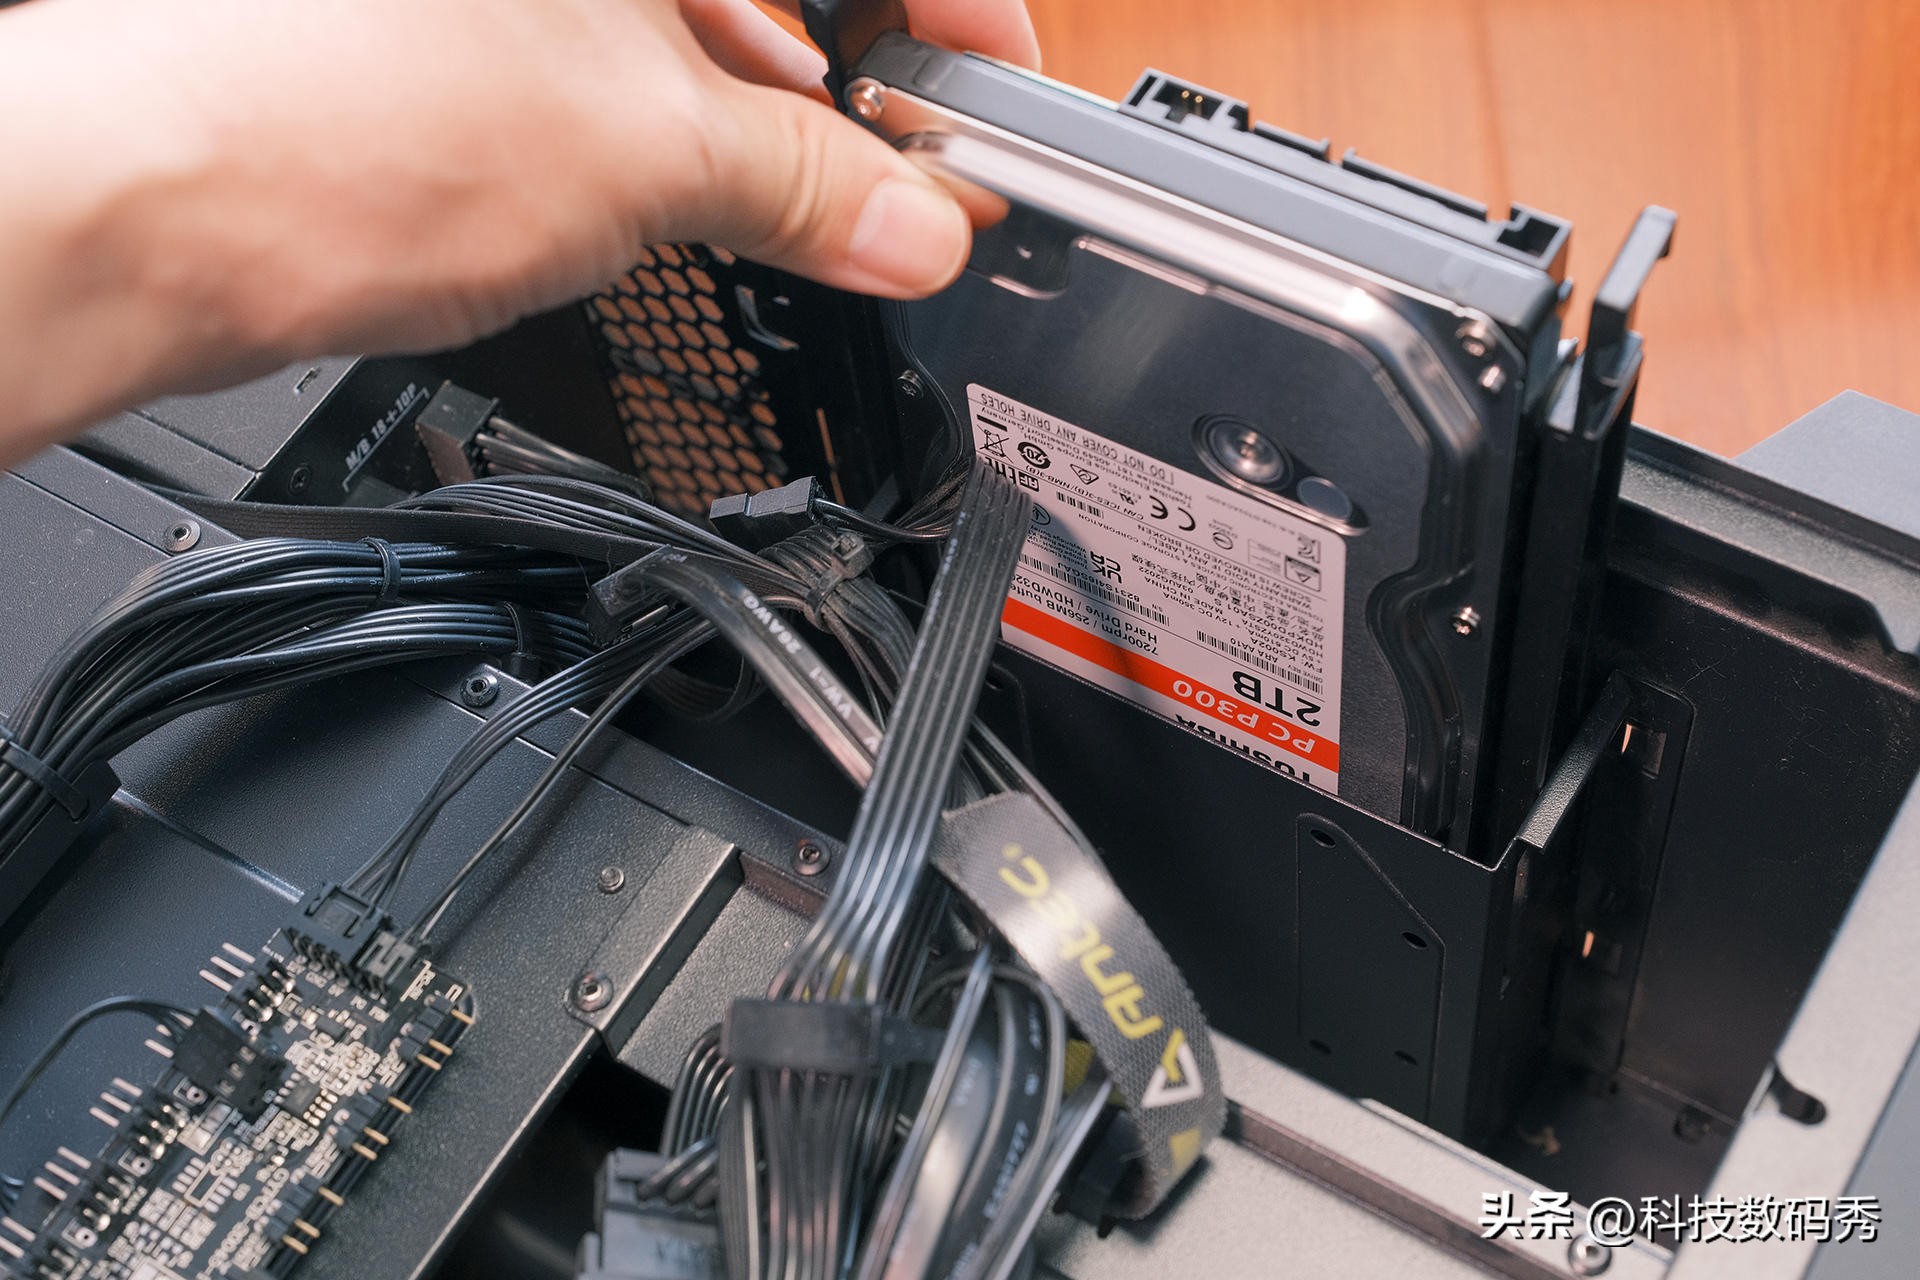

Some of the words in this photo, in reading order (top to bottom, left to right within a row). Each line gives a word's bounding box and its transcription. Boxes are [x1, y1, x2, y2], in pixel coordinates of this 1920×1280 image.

[981, 393, 1015, 418] HOLES
[1020, 409, 1051, 432] DRIVE
[1056, 425, 1076, 443] ANY
[345, 438, 371, 470] M/B
[1026, 448, 1042, 463] 20
[1057, 447, 1092, 466] Europe
[1082, 436, 1117, 460] COVER
[1123, 454, 1144, 472] NOT
[1150, 465, 1165, 482] DO
[1124, 508, 1143, 520] CAN
[1078, 513, 1138, 543] CORPORATION
[1138, 524, 1181, 548] BROKEN
[1141, 540, 1180, 561] STORAGE
[1185, 545, 1200, 555] OR
[1188, 554, 1208, 566] ANY
[1190, 562, 1226, 581] DEVICES
[1203, 553, 1255, 579] REMOVED
[1224, 569, 1249, 584] VOID
[1139, 566, 1193, 594] 03AUG2022
[1144, 576, 1176, 595] CHINA
[1180, 592, 1190, 601] IN
[1229, 578, 1283, 606] ELECTRONIC
[1253, 582, 1311, 610] WARRANTY
[1046, 600, 1089, 626] 256MB
[1086, 605, 1120, 628] Drive
[1194, 598, 1223, 615] MADE
[1198, 607, 1212, 618] DC
[1286, 603, 1323, 623] TOSHIBA
[743, 595, 801, 654] 26AWG
[1124, 622, 1157, 644] Hard
[1101, 620, 1158, 656] 7200rpm
[1230, 638, 1254, 653] AA10
[1250, 637, 1295, 662] KS002A
[1257, 649, 1278, 663] ARA
[1284, 645, 1299, 656] DC
[809, 665, 852, 719] VW-1
[1232, 671, 1321, 727] 2TB
[1173, 680, 1259, 729] P300
[1268, 722, 1315, 754] PC
